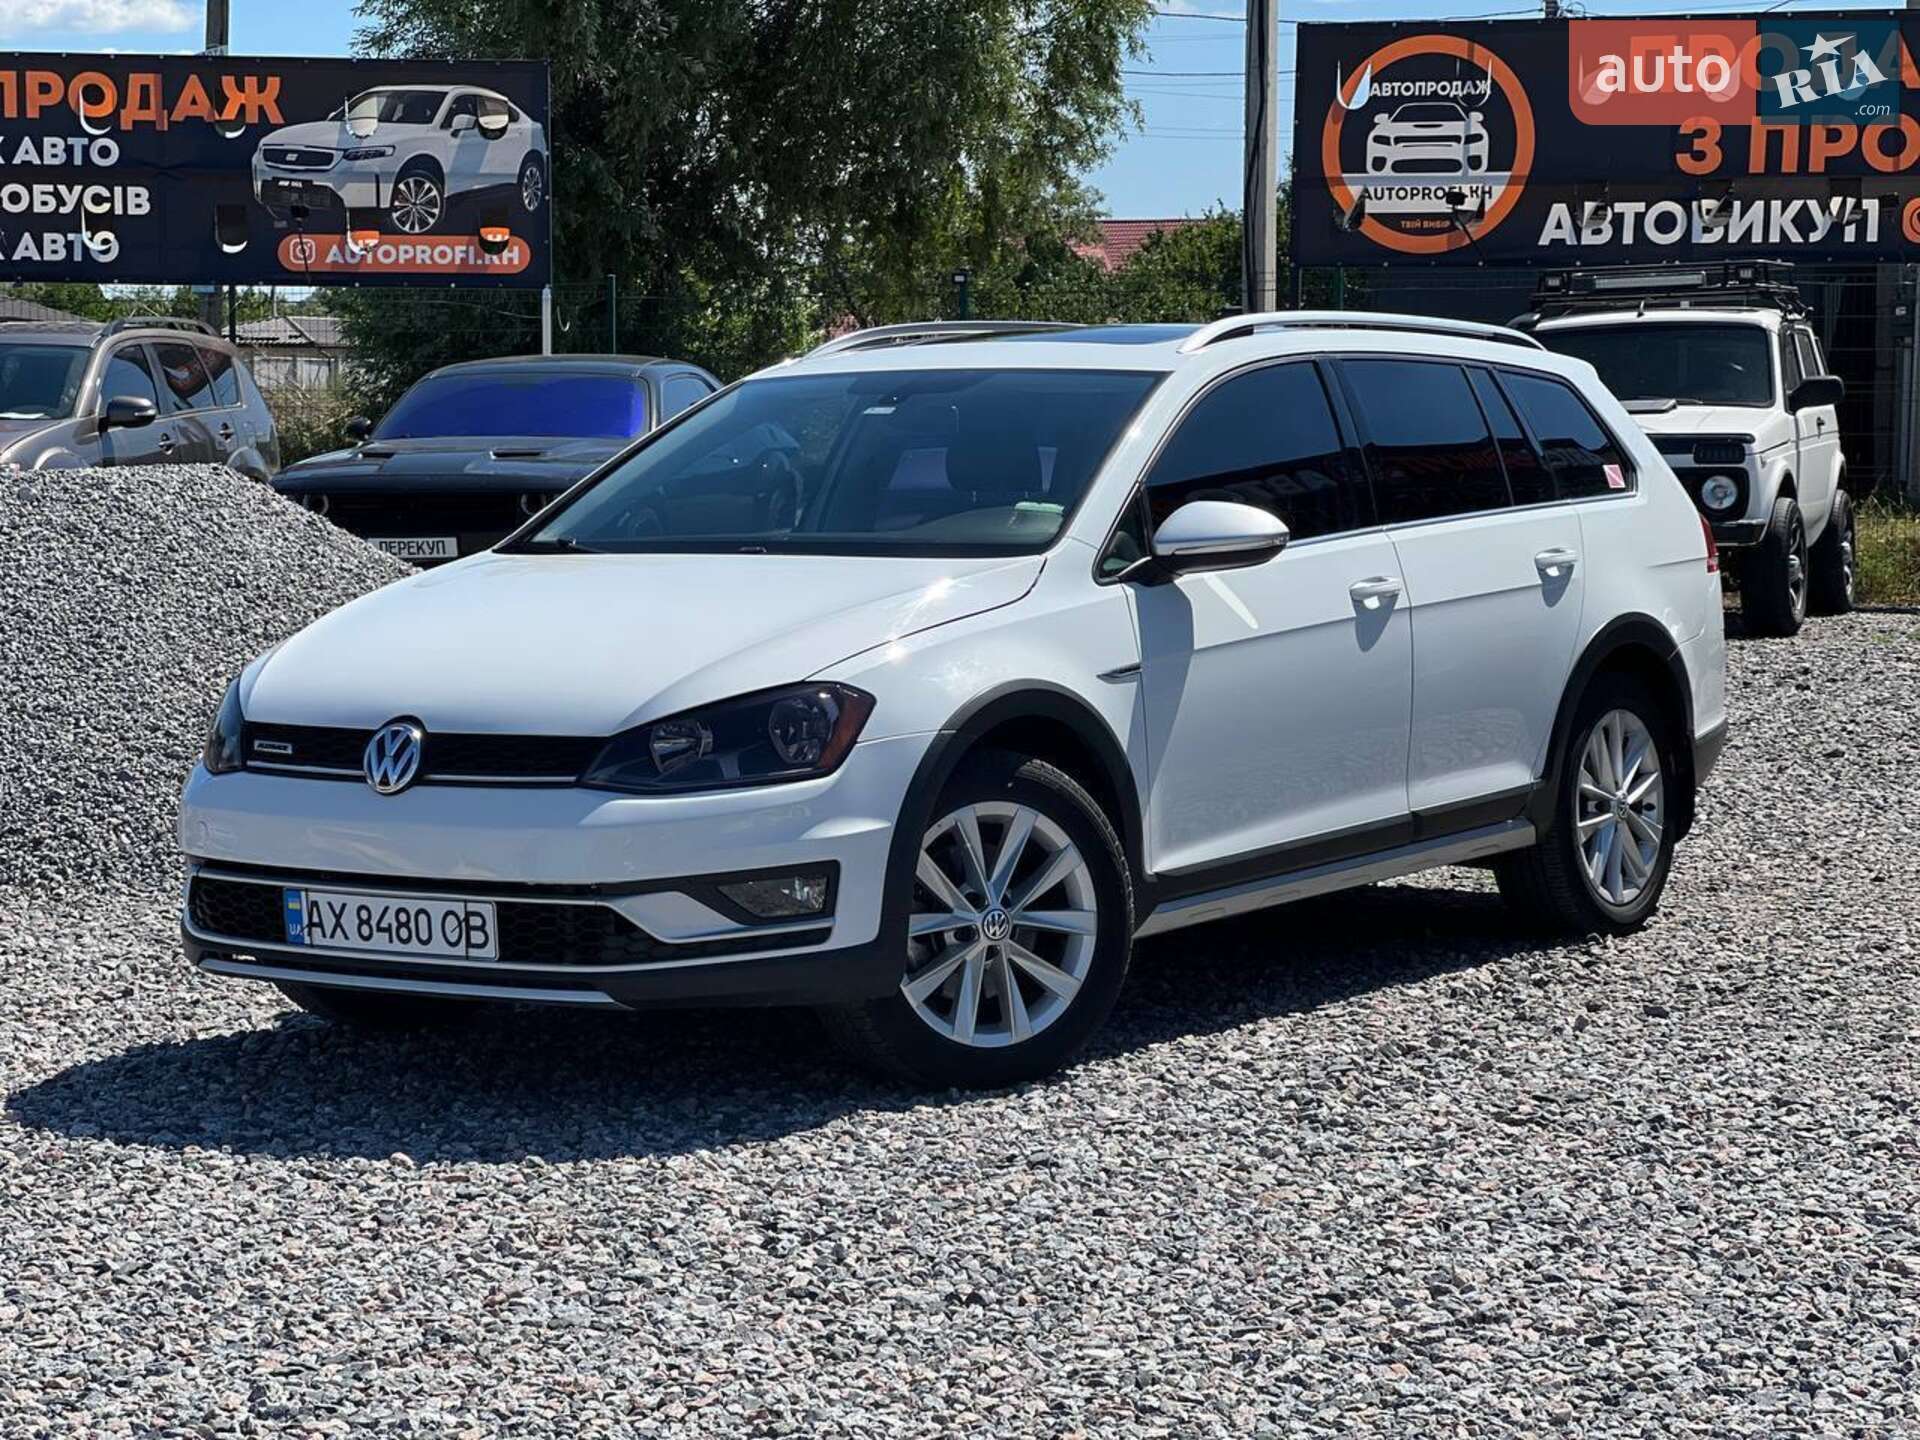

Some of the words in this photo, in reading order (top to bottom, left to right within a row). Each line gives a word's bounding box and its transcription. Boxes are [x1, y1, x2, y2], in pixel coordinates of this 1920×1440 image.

[1370, 80, 1491, 97] АВТОПРОДАЖ
[12, 136, 120, 167] АВТО
[0, 183, 151, 216] ОБУСІВ
[1364, 185, 1494, 200] AUTOPROIKH
[1538, 197, 1880, 245] АВТОВИКУП
[12, 231, 120, 263] АВТО
[380, 540, 447, 556] ПЕРЕКУП
[309, 900, 349, 940] AX
[356, 904, 433, 946] 8480
[441, 909, 490, 949] OB
